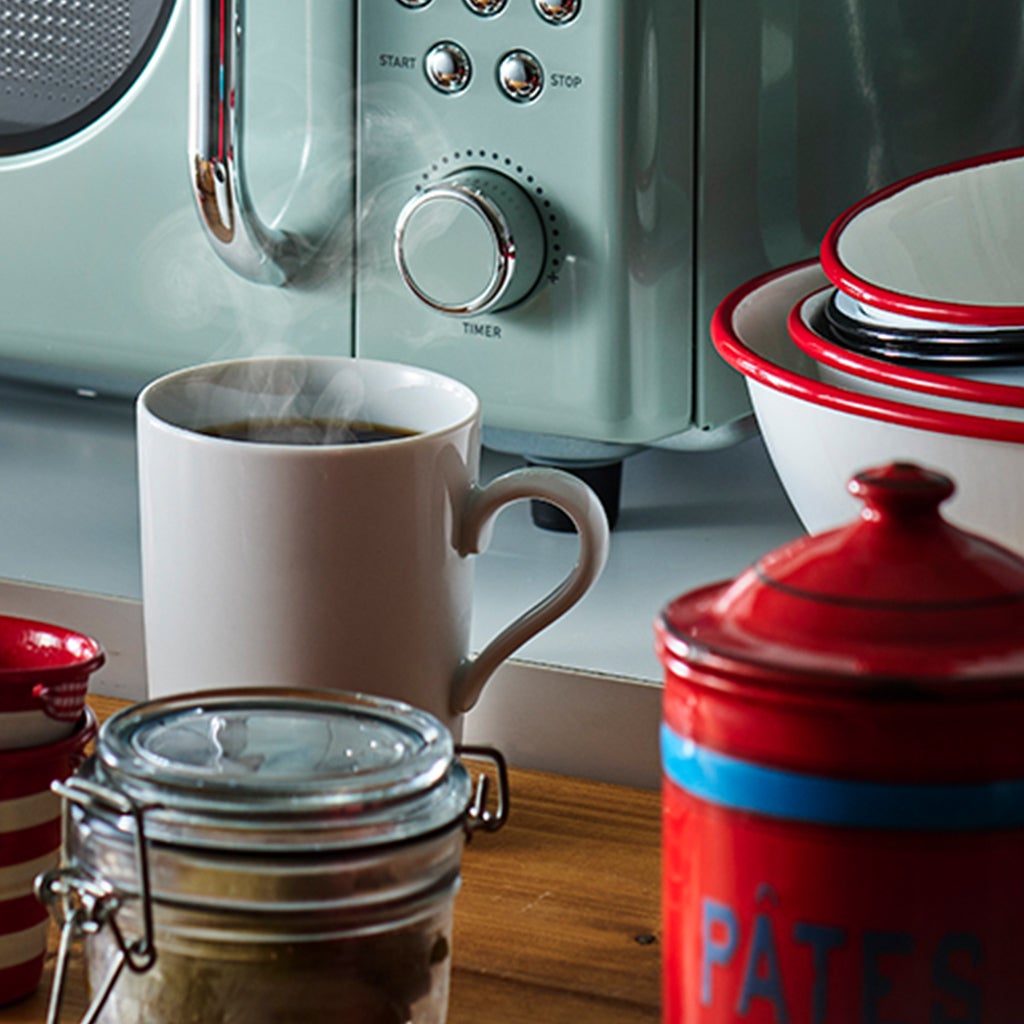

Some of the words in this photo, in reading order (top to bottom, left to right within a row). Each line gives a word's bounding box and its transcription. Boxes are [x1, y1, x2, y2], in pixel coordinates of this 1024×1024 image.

[379, 55, 416, 68] START
[550, 74, 581, 88] STOP
[462, 322, 502, 338] TIMER
